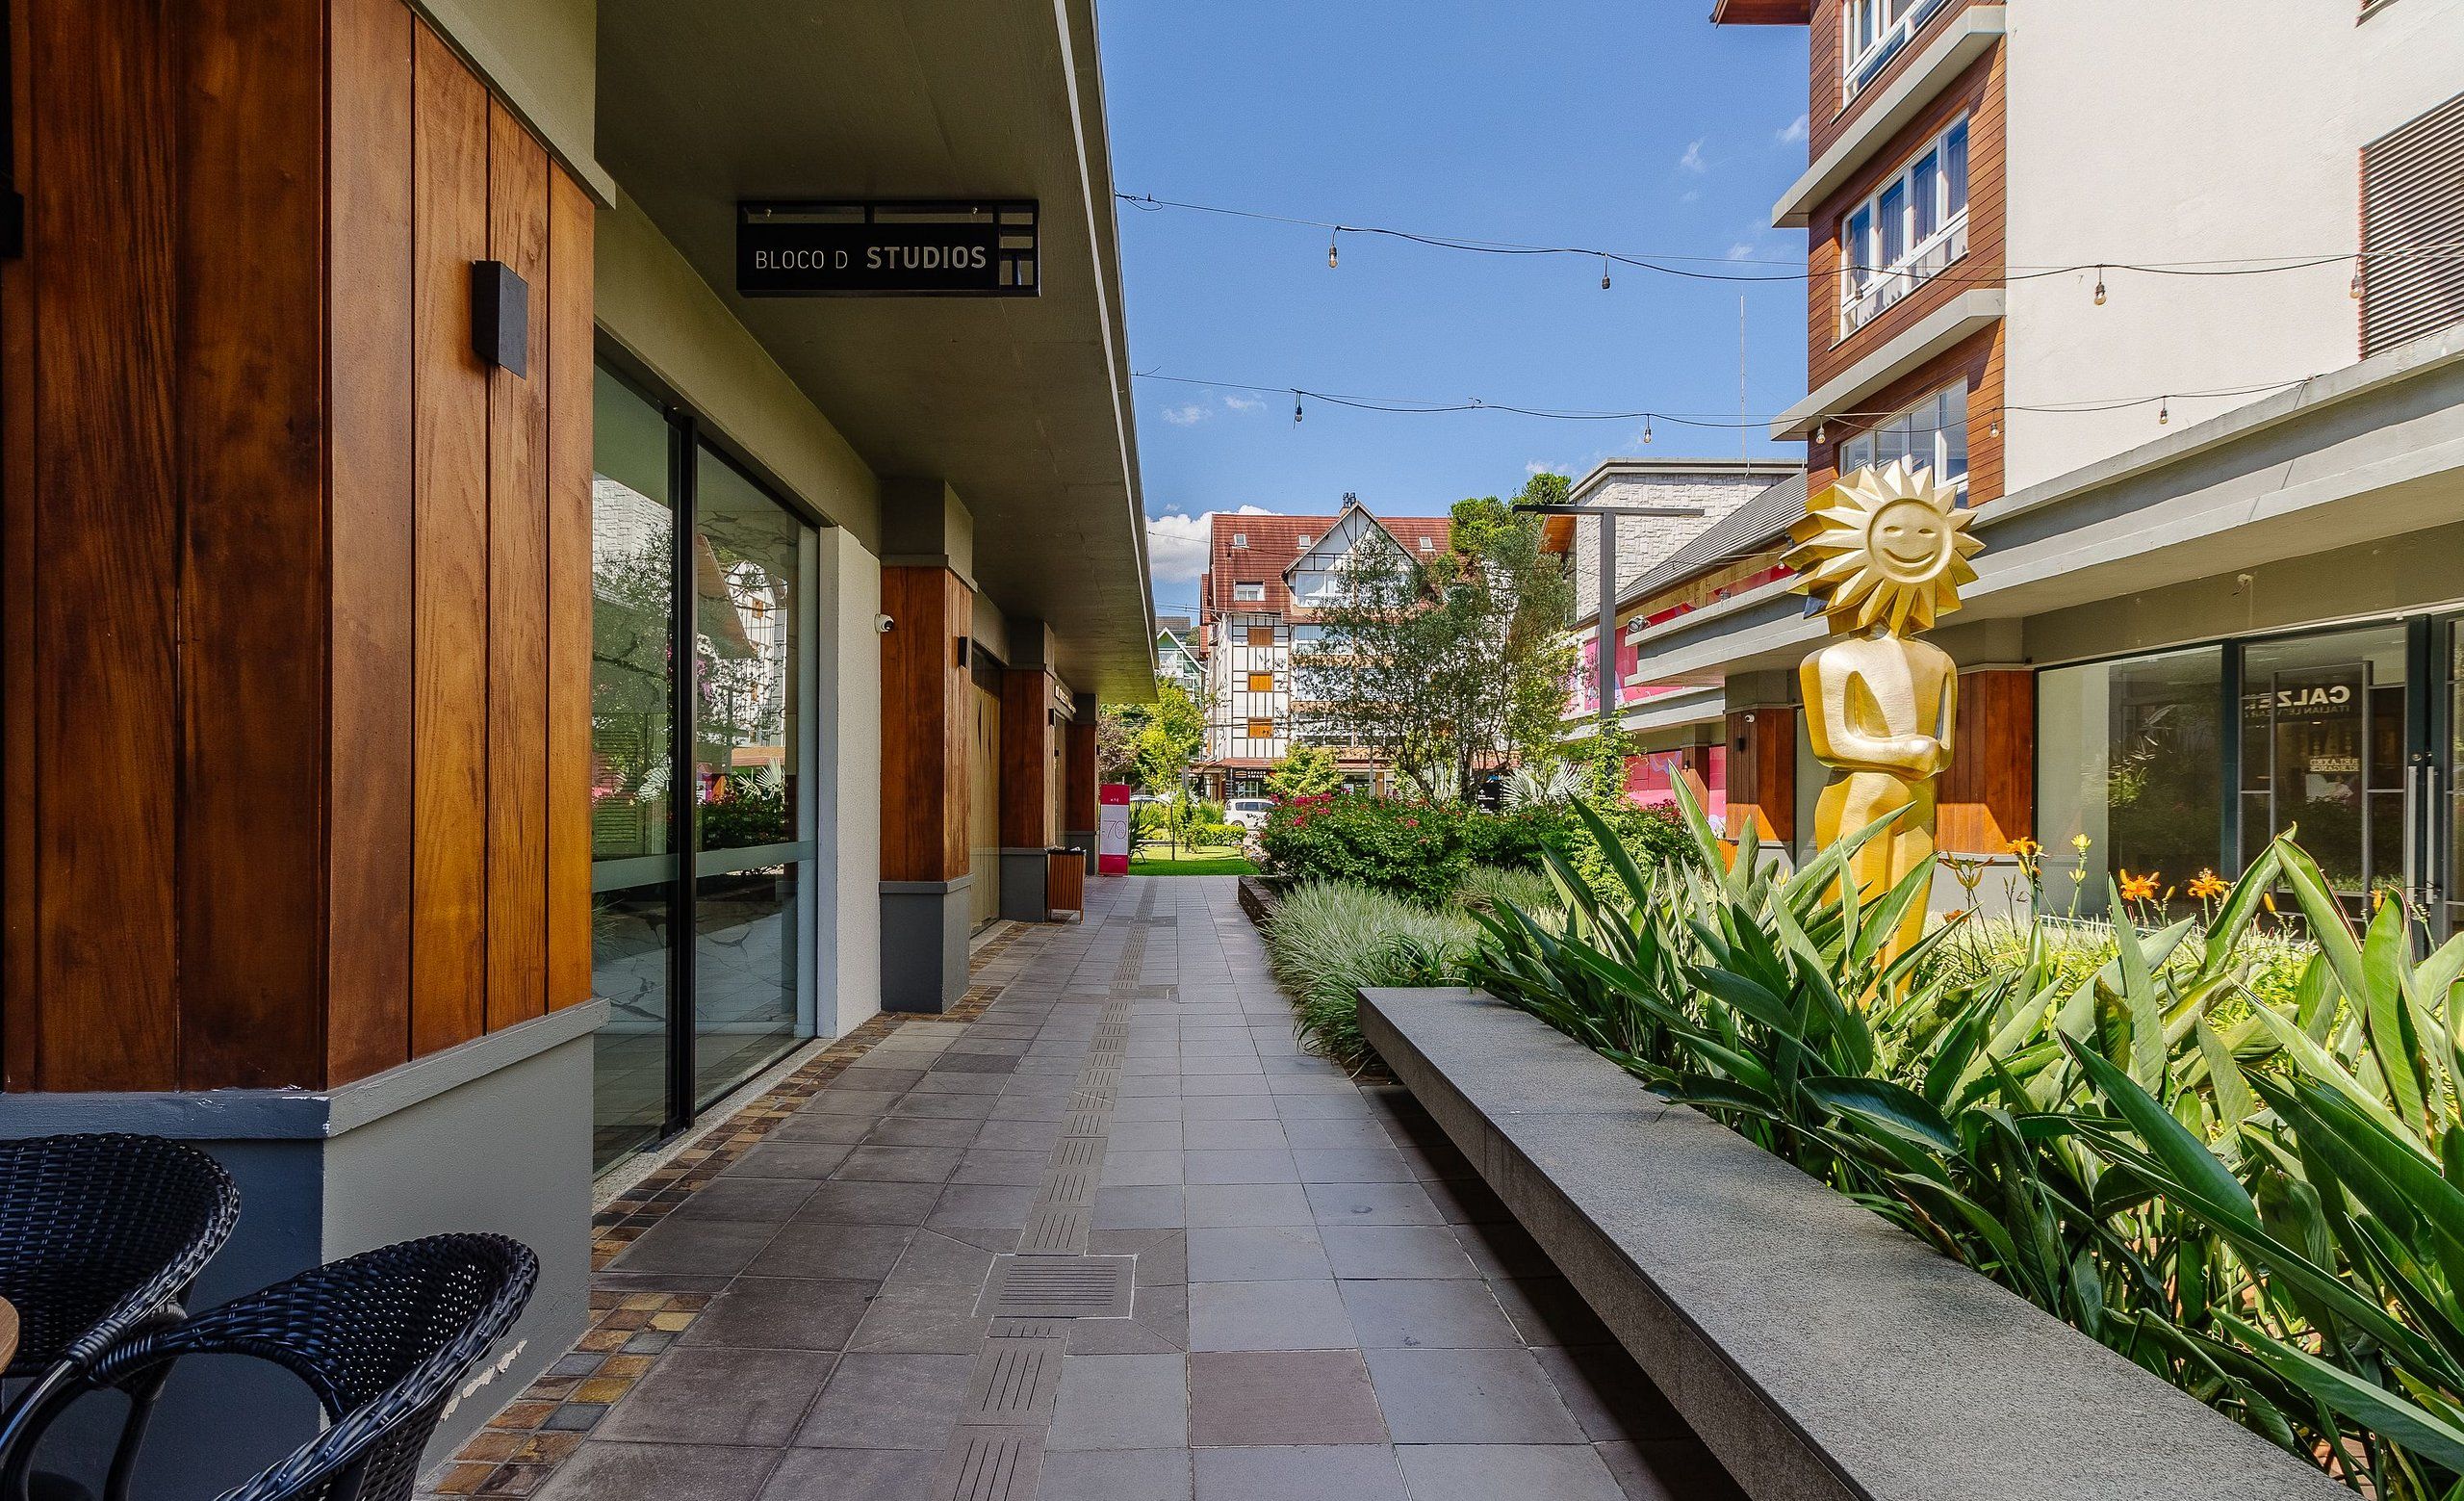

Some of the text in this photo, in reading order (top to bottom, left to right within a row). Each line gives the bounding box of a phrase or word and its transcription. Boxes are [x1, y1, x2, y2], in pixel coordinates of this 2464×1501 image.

[756, 246, 987, 269] BLOCO D STUDIOS
